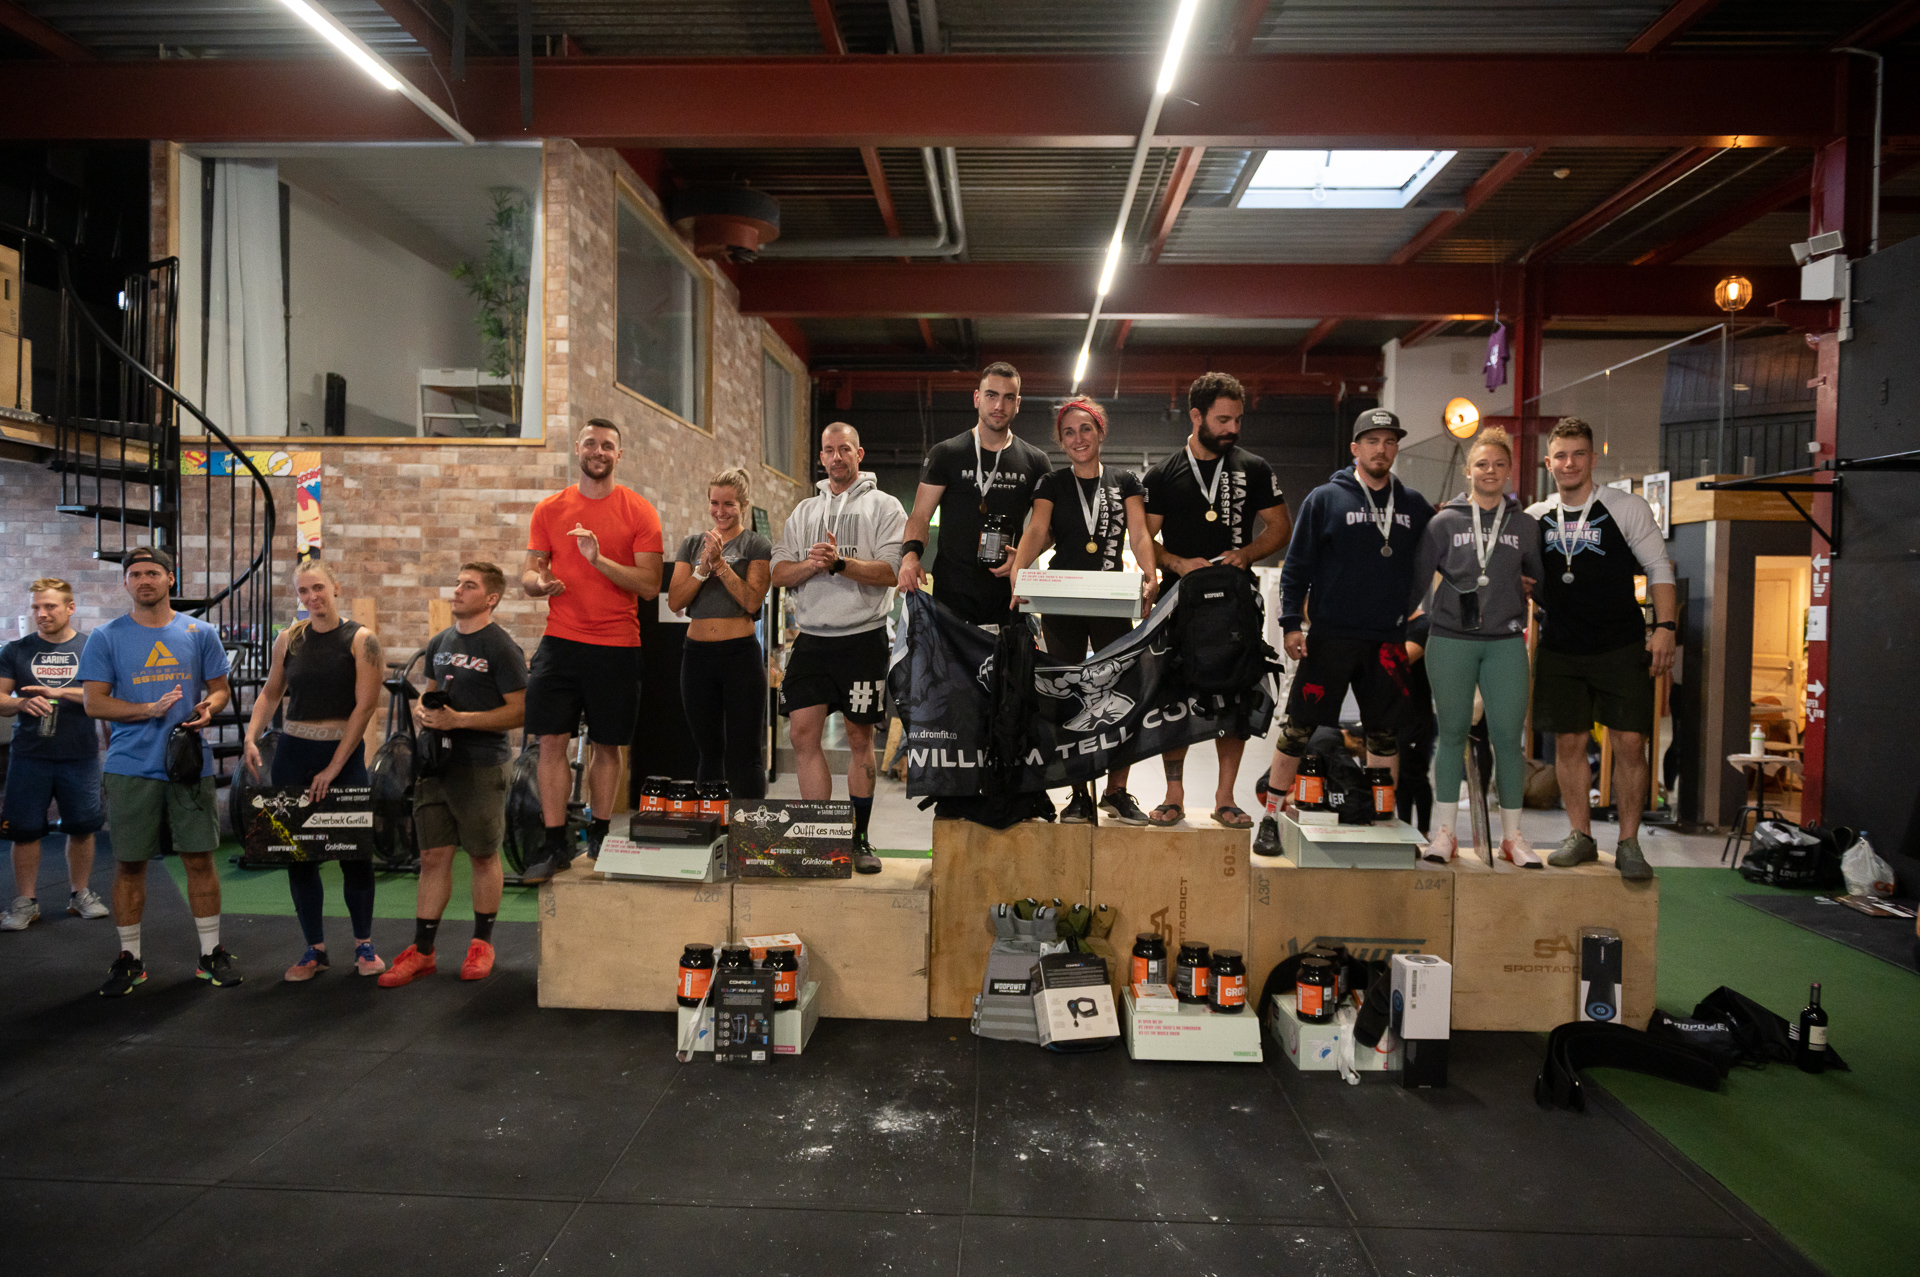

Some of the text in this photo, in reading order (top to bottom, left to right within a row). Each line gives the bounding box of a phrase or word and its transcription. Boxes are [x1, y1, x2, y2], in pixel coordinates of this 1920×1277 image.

[961, 469, 1027, 484] MYAMA
[1221, 471, 1231, 526] CROSSFIT
[1099, 487, 1110, 537] CROSSFIT
[1101, 486, 1124, 571] MAYAMA
[36, 667, 73, 676] CROSSFIT
[41, 655, 70, 664] SARINE
[849, 679, 886, 713] #1
[907, 748, 1045, 769] WILLIM
[1055, 726, 1134, 760] TELL
[310, 815, 369, 825] Silverback Gorilla
[793, 825, 816, 837] Oufff
[816, 828, 828, 836] ces
